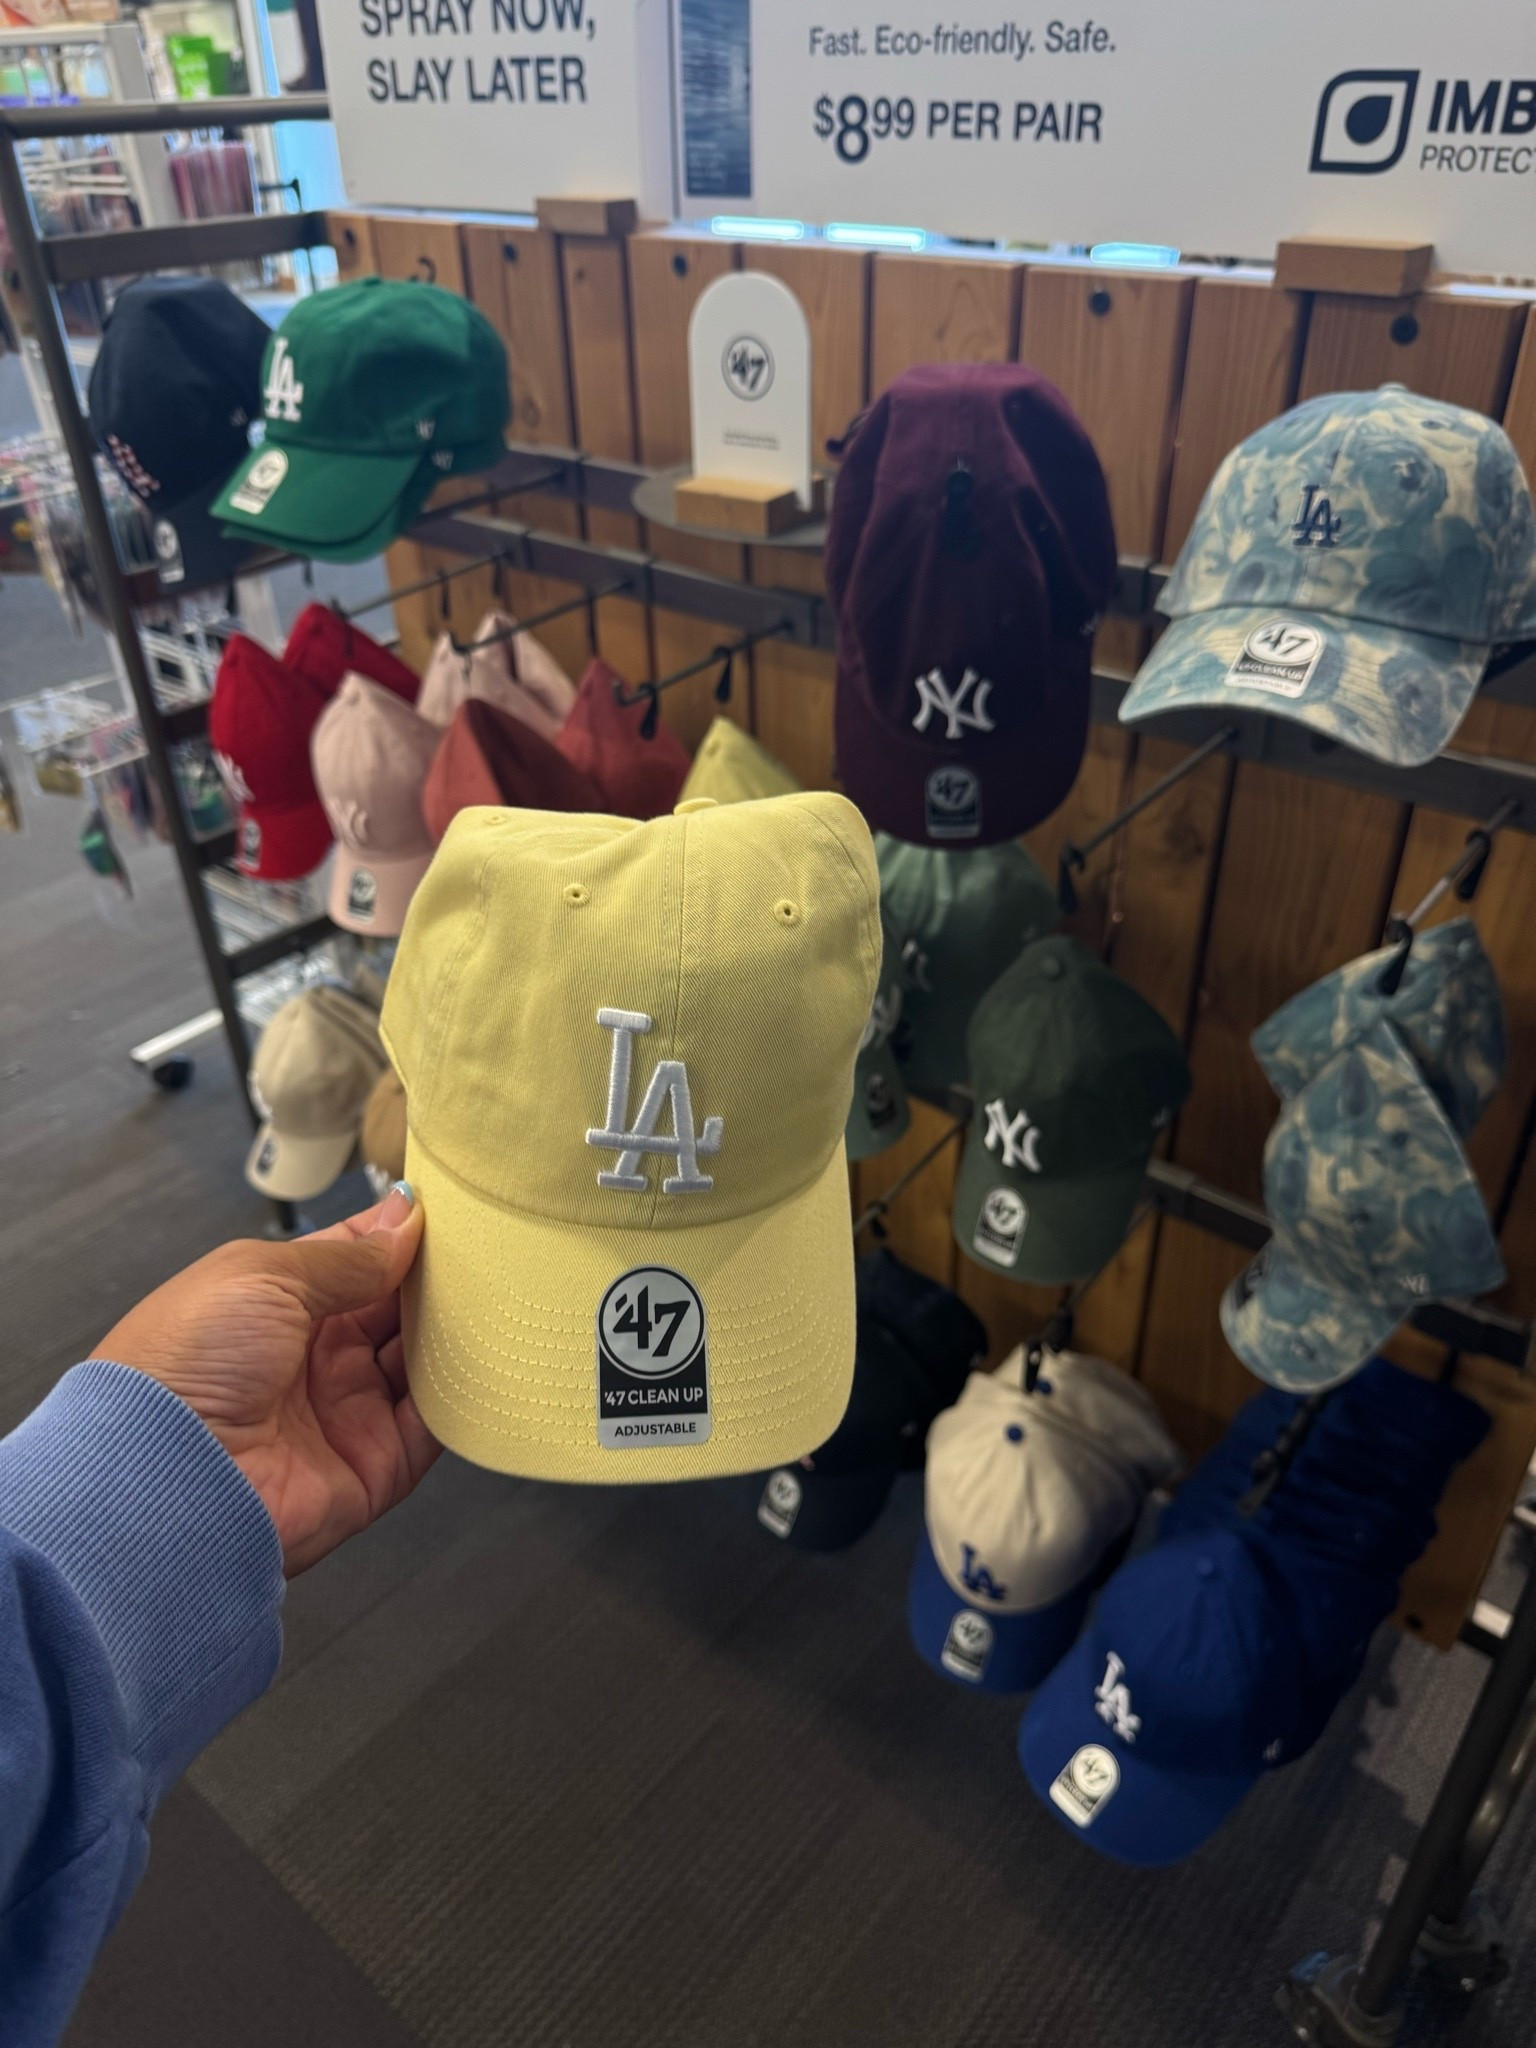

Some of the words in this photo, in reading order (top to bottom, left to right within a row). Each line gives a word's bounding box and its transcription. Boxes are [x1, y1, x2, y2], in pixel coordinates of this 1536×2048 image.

[360, 0, 475, 37] SPRAY
[492, 0, 595, 41] NOW,
[809, 26, 867, 57] Fast.
[874, 22, 1035, 62] Eco-friendly.
[1045, 20, 1116, 53] Safe.
[367, 57, 453, 103] SLAY
[466, 56, 587, 103] LATER
[1427, 79, 1536, 135] IMB
[926, 101, 1000, 140] PER
[1013, 101, 1103, 143] PAIR
[1420, 145, 1536, 174] PROTEC
[264, 338, 304, 421] LA
[1292, 484, 1342, 548] LA
[912, 666, 996, 740] NY
[585, 1007, 724, 1194] LA
[983, 1098, 1042, 1173] NY
[627, 1387, 680, 1406] CLEAN
[683, 1386, 704, 1403] UP
[614, 1422, 697, 1438] ADJUSTABLE
[960, 1542, 1006, 1601] LA
[1095, 1651, 1142, 1744] LA
